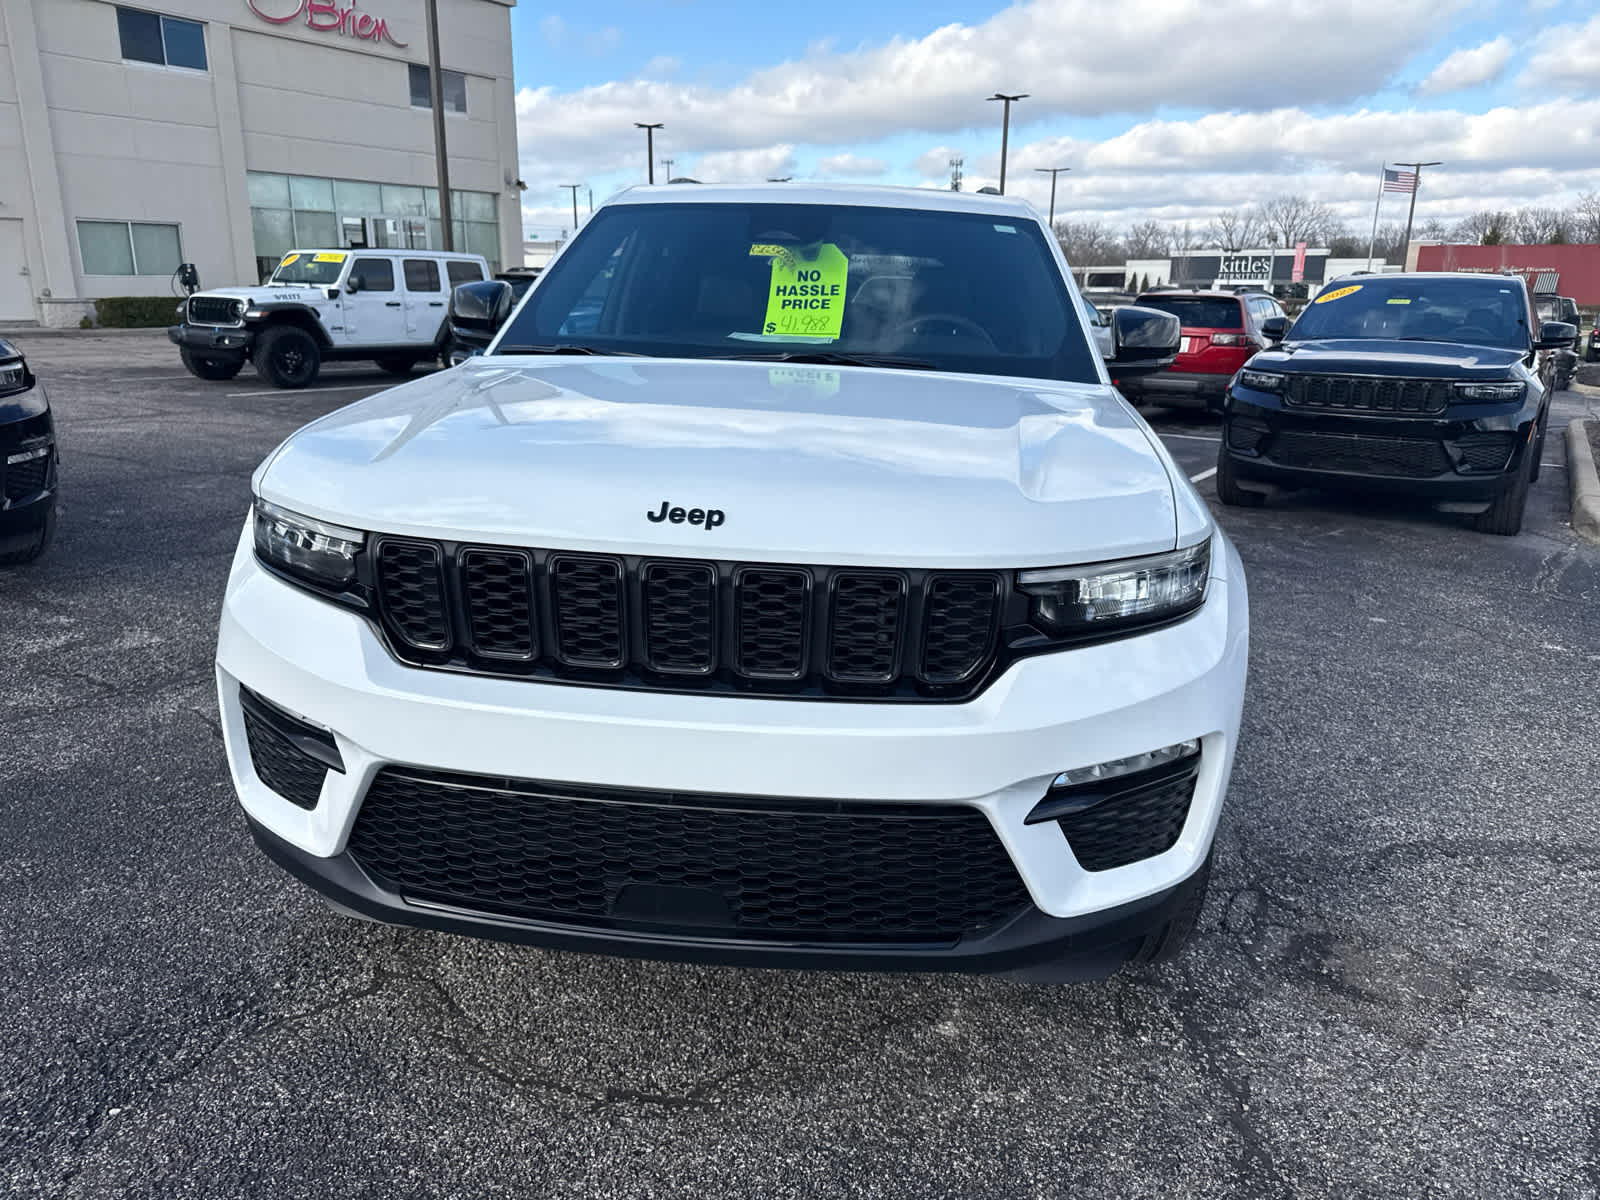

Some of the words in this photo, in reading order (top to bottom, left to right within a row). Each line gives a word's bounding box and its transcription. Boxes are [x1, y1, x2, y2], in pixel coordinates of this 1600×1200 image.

[247, 0, 408, 47] OBrien
[1218, 255, 1270, 272] kittle's
[797, 270, 821, 283] NO
[776, 284, 840, 297] HASSLE
[781, 298, 831, 310] PRICE
[765, 321, 777, 334] $
[647, 501, 725, 531] Jeep
